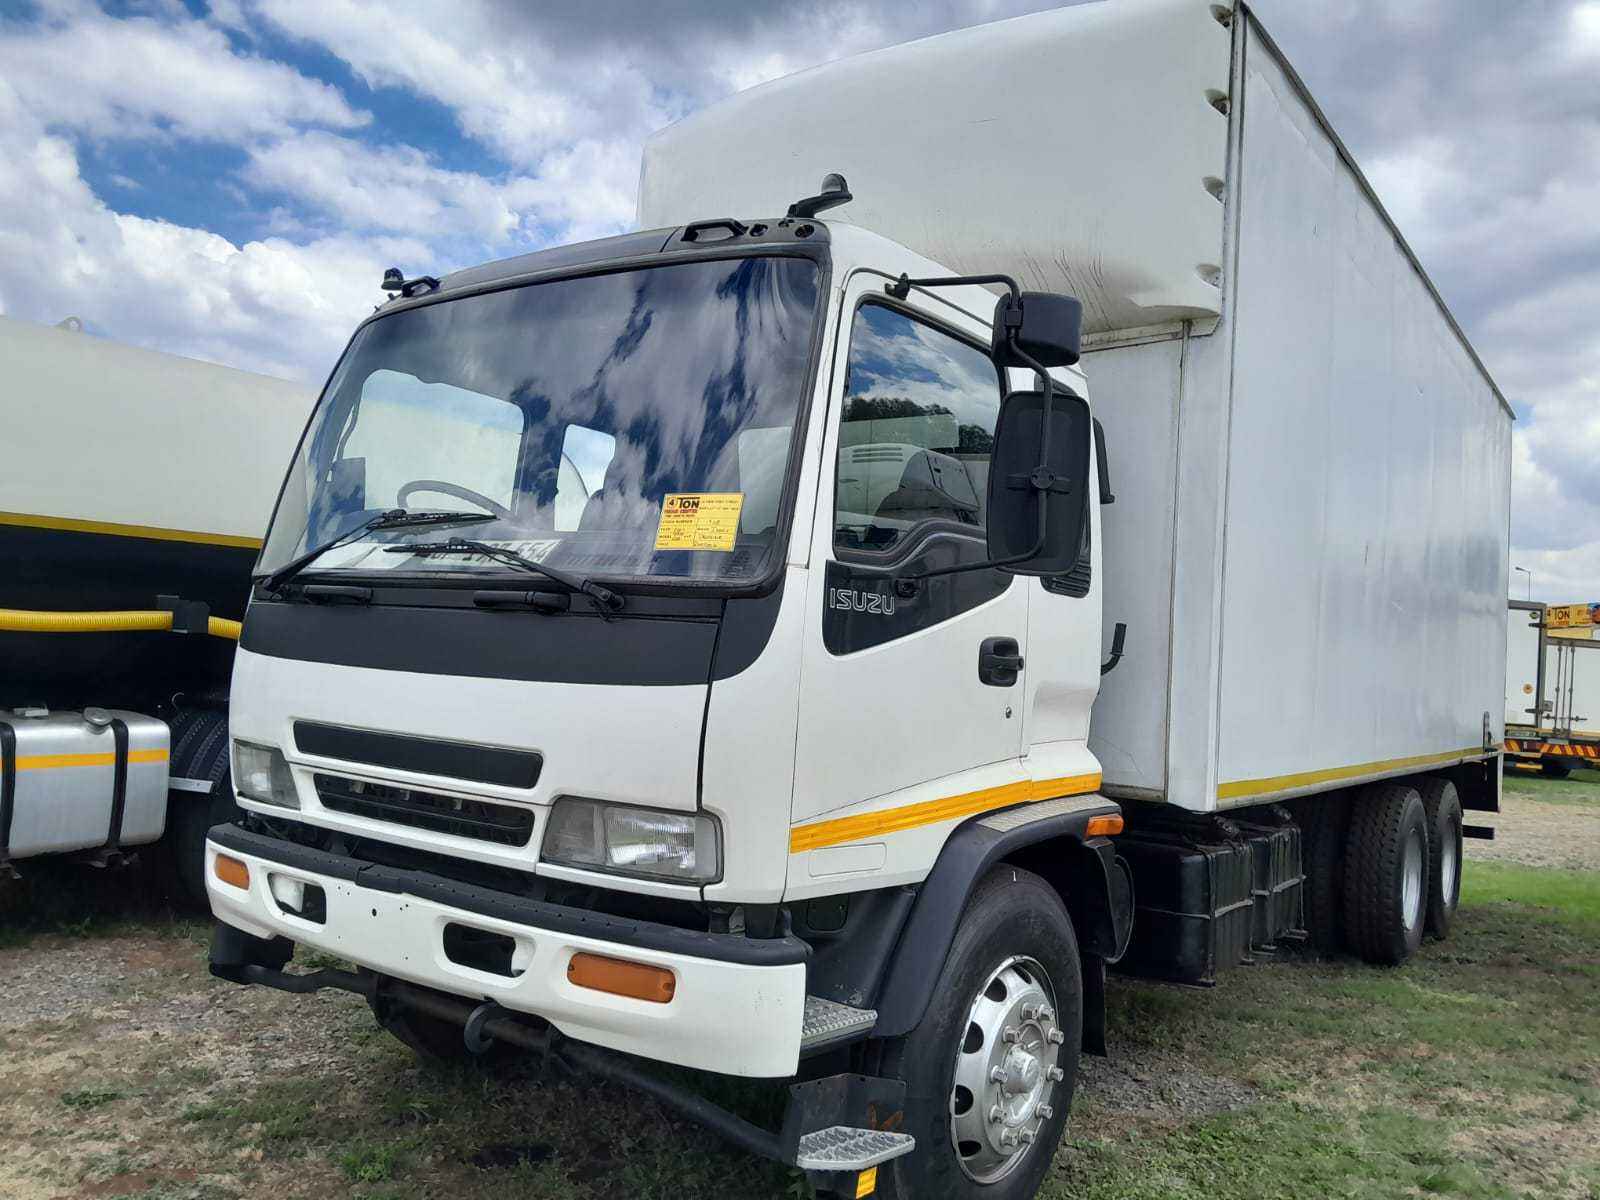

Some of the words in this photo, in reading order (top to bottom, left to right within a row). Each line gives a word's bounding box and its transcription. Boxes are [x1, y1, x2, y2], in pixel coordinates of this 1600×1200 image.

[677, 497, 700, 509] TON
[829, 587, 895, 615] ISUZU
[1552, 606, 1570, 620] TON
